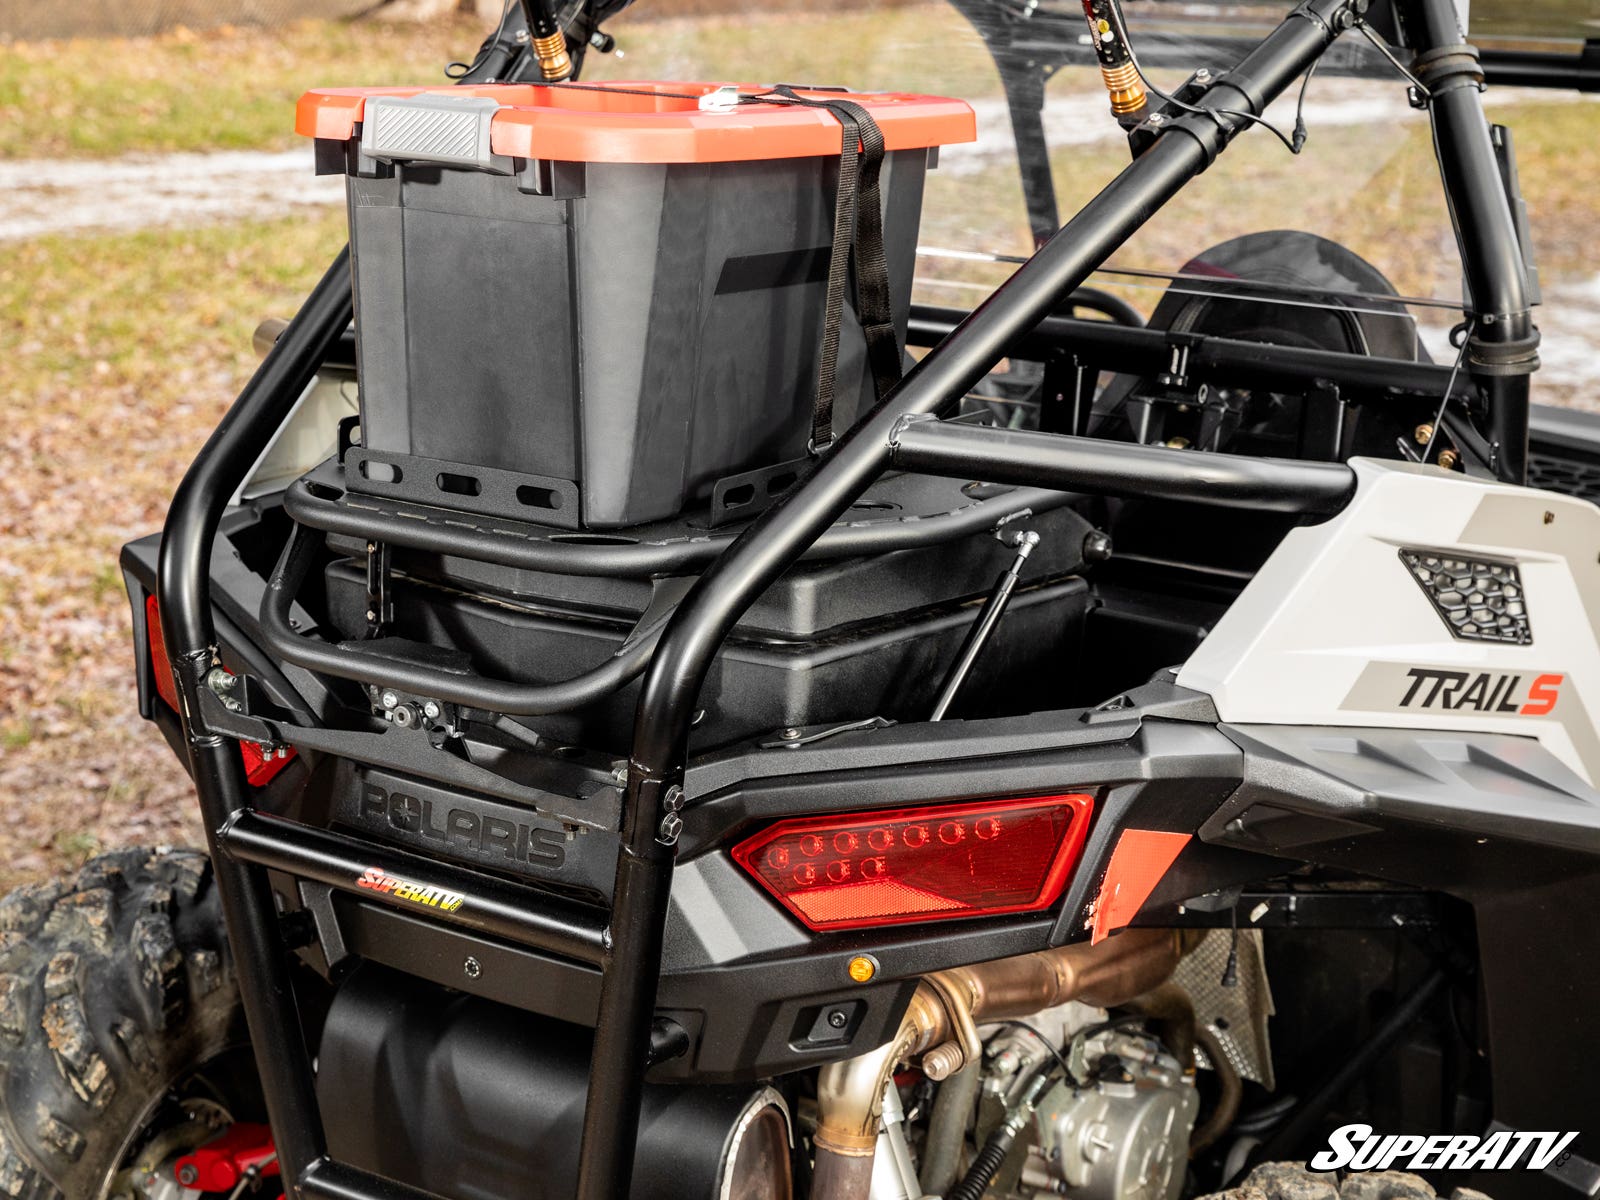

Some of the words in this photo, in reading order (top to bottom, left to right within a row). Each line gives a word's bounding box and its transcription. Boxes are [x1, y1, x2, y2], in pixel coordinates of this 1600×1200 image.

[1399, 668, 1521, 712] TRAIL
[1519, 674, 1564, 715] S
[359, 782, 567, 870] POLARIS
[357, 867, 464, 910] SUPERATV
